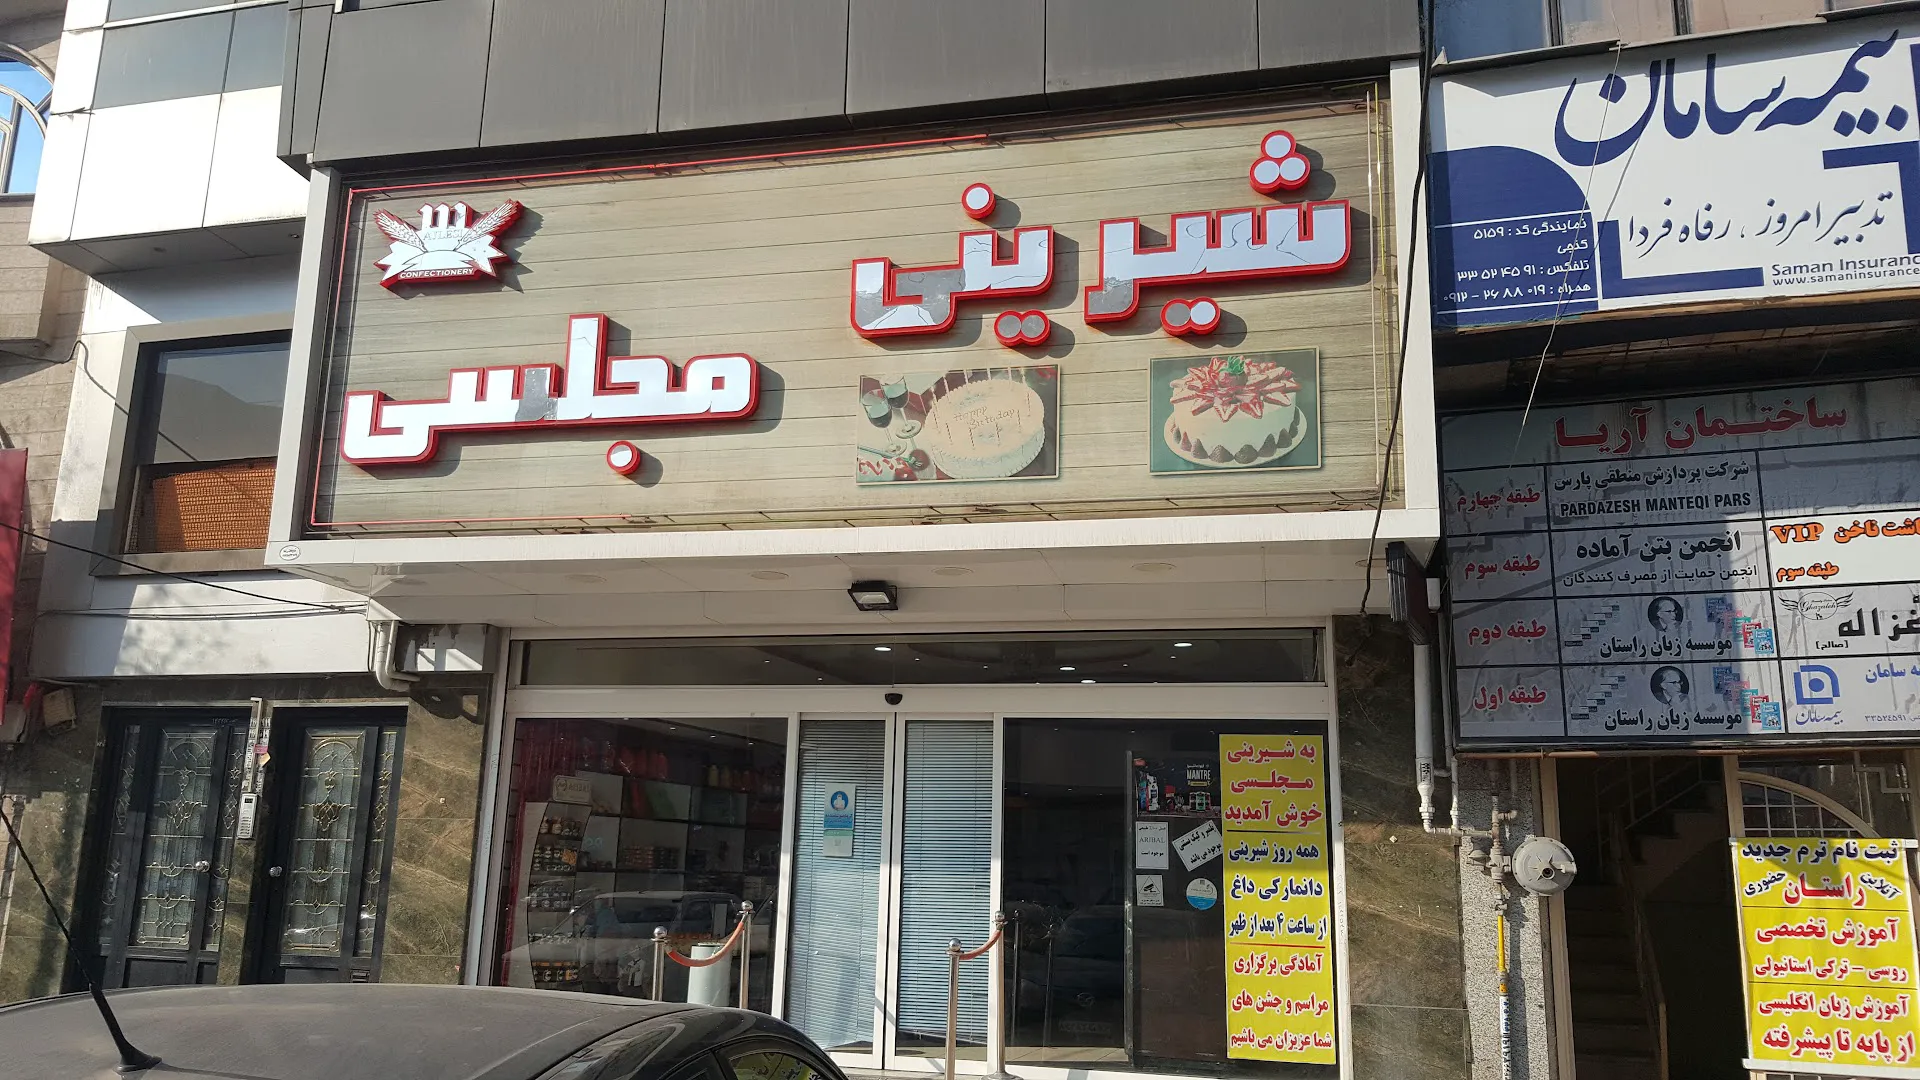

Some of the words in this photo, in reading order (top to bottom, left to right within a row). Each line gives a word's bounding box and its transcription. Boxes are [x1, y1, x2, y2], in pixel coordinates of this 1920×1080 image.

[1755, 29, 1909, 137] بیمه
[1555, 53, 1786, 166] سامان
[1532, 218, 1587, 236] نمایندگی
[1629, 197, 1673, 259] فردا
[1679, 202, 1731, 242] رفاه
[1815, 191, 1893, 246] تدبیر
[850, 130, 1352, 347] شیرینی
[1474, 227, 1504, 239] ۵۱۵۹
[400, 268, 474, 279] CONFECTIONERY
[1772, 262, 1833, 276] Saman
[1839, 255, 1920, 271] Insuranc
[341, 313, 760, 476] مجلسی
[953, 405, 988, 421] Happy
[1665, 397, 1848, 449] ساختمان
[1554, 405, 1654, 454] آریا
[1554, 471, 1591, 491] پارس
[1595, 468, 1641, 489] منطقی
[1645, 465, 1701, 485] پردازش
[1705, 461, 1749, 481] شرکت
[1457, 489, 1502, 512] چهارم
[1506, 487, 1541, 508] طبقه
[1560, 500, 1641, 517] PARDAZESH
[1646, 496, 1709, 512] MANTEQI
[1714, 492, 1751, 507] PARS
[1770, 522, 1825, 544] VIP
[1834, 519, 1880, 544] ناخن
[1882, 516, 1920, 537] اشت
[1576, 533, 1632, 559] آماده
[1639, 536, 1672, 562] بتن
[1679, 530, 1742, 560] انجمن
[1465, 560, 1498, 579] سوم
[1503, 554, 1540, 577] طبقه
[1661, 569, 1671, 584] از
[1675, 568, 1716, 580] حمایت
[1720, 565, 1757, 580] انجمن
[1777, 567, 1805, 582] سوم
[1807, 561, 1839, 580] طبقه
[1563, 571, 1614, 587] کنندگان
[1618, 572, 1657, 585] مصرف
[1468, 624, 1502, 646] دوم
[1506, 619, 1547, 643] طبقه
[1600, 636, 1647, 658] راستان
[1650, 635, 1682, 657] زبان
[1685, 638, 1733, 655] موسسه
[1865, 662, 1906, 683] سامان
[1474, 686, 1504, 711] اول
[1508, 685, 1546, 709] طبقه
[1604, 708, 1653, 731] راستان
[1657, 708, 1690, 731] زبان
[1693, 709, 1742, 730] موسسه
[1227, 740, 1295, 764] شیرینی
[1299, 744, 1315, 764] به
[1231, 770, 1314, 794] مجلسی
[1225, 800, 1272, 825] آمدید
[1276, 803, 1322, 827] خوش
[1229, 840, 1269, 862] شیرینی
[1271, 843, 1293, 863] روز
[1296, 844, 1319, 858] همه
[1743, 843, 1791, 862] جدید
[1797, 841, 1827, 863] ترم
[1832, 841, 1858, 863] نام
[1864, 840, 1898, 863] ثبت
[1231, 874, 1255, 899] داغ
[1259, 877, 1323, 901] دانمارکی
[1745, 871, 1785, 895] حضوری
[1784, 872, 1865, 906] راستان
[1860, 872, 1901, 898] آنلاین
[1229, 912, 1246, 937] ظهر
[1249, 913, 1257, 937] از
[1259, 917, 1275, 937] بعد
[1276, 912, 1284, 934] ۴
[1287, 915, 1315, 933] ساعت
[1317, 916, 1327, 940] از
[1757, 918, 1826, 942] تخصصی
[1832, 918, 1899, 946] آموزش
[1234, 952, 1277, 975] برگزاری
[1280, 953, 1323, 975] آمادگی
[1816, 959, 1849, 979] ترکی
[1868, 966, 1907, 981] روسی
[1232, 989, 1253, 1011] های
[1256, 991, 1282, 1013] جشن
[1285, 999, 1292, 1014] و
[1295, 993, 1329, 1016] مراسم
[1759, 993, 1814, 1015] انگلیسی
[1819, 994, 1850, 1017] زبان
[1855, 995, 1909, 1020] آموزش
[1231, 1028, 1255, 1047] باشیم
[1257, 1034, 1273, 1049] می
[1275, 1030, 1311, 1051] عزیزان
[1313, 1032, 1332, 1048] شما
[1763, 1024, 1833, 1059] پیشرفته
[1836, 1029, 1850, 1051] تا
[1856, 1031, 1890, 1061] پایه
[1897, 1032, 1914, 1062] از
